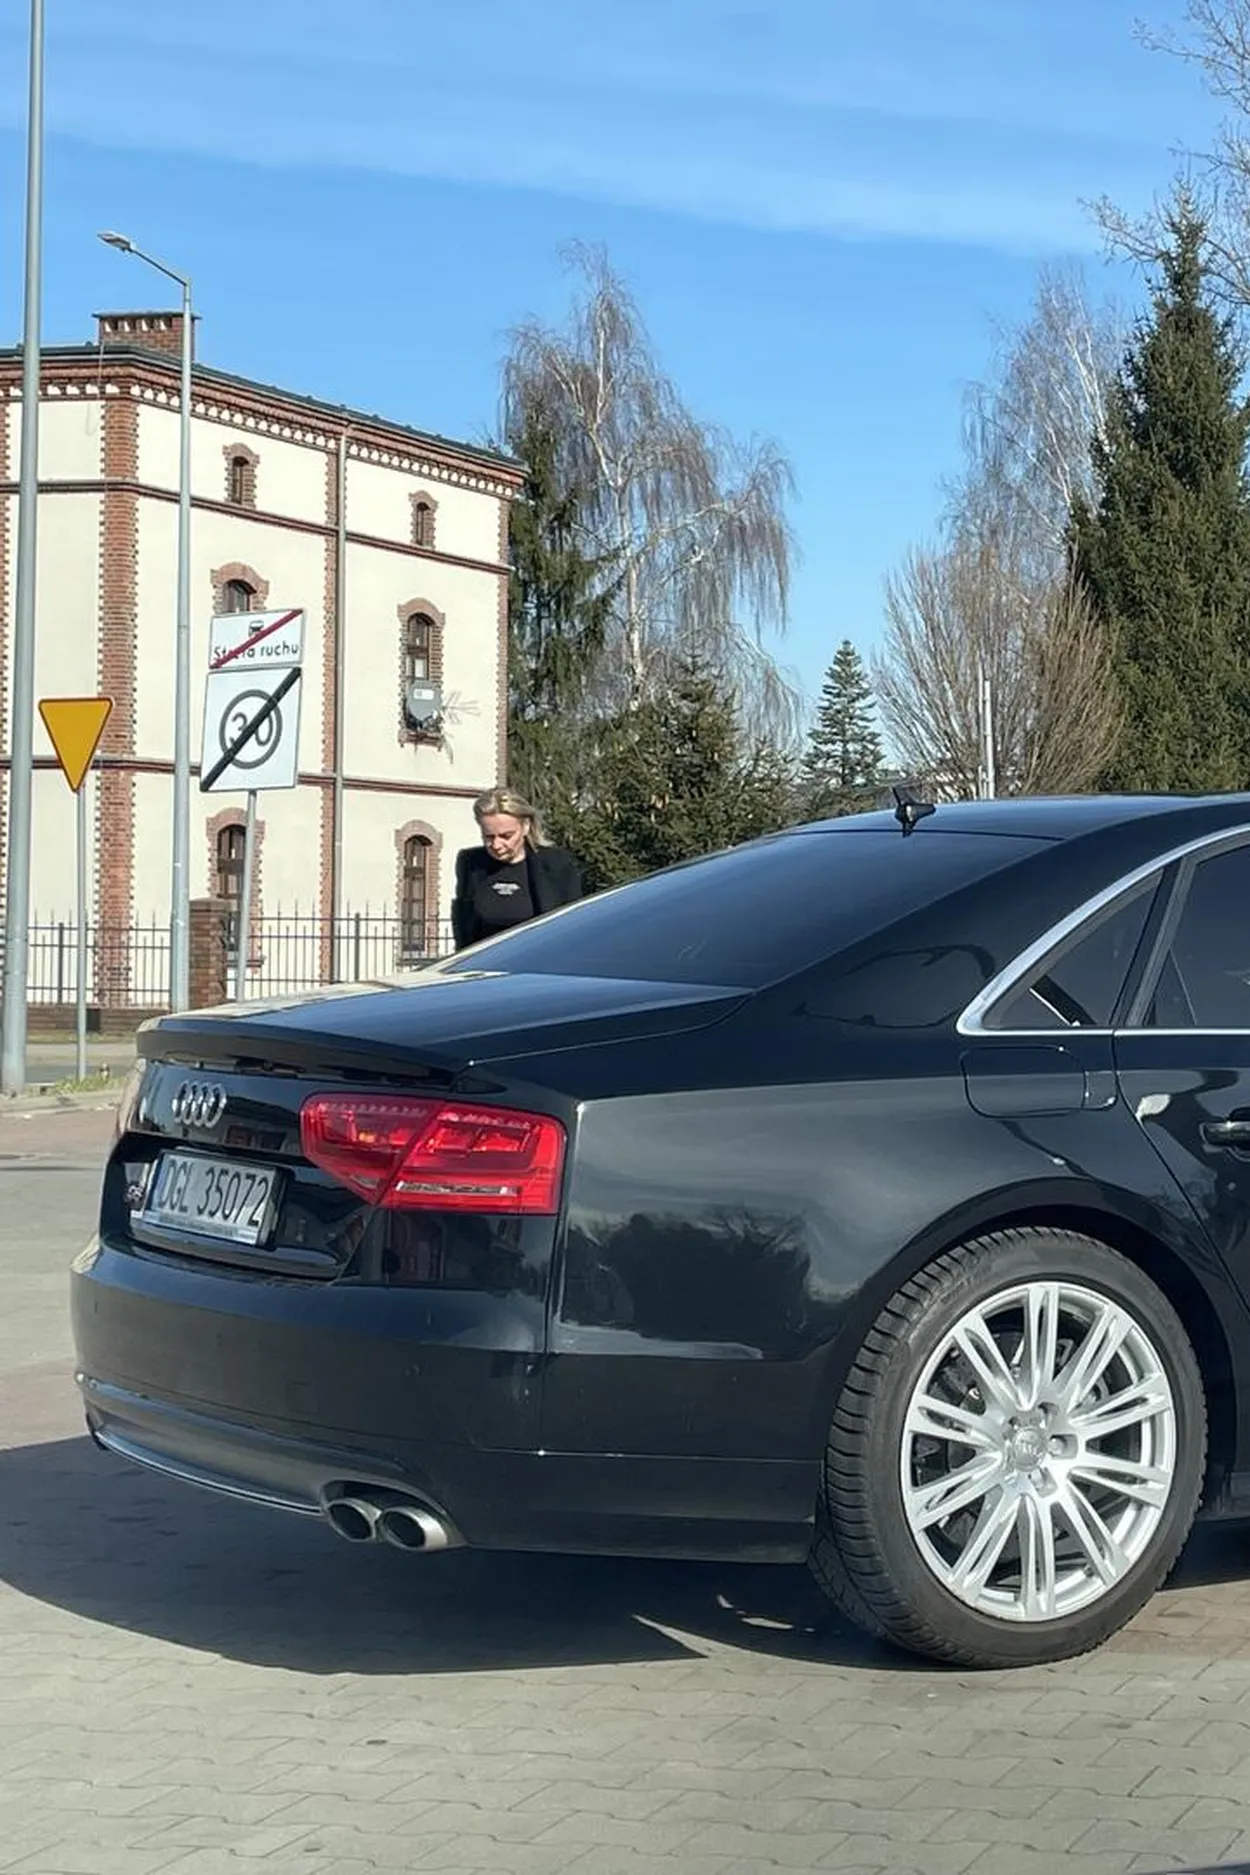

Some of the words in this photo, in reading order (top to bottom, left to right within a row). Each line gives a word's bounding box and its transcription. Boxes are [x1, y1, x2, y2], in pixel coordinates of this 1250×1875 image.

[260, 640, 299, 657] ruchu
[158, 1158, 195, 1214] DGL
[196, 1165, 270, 1228] 35072
